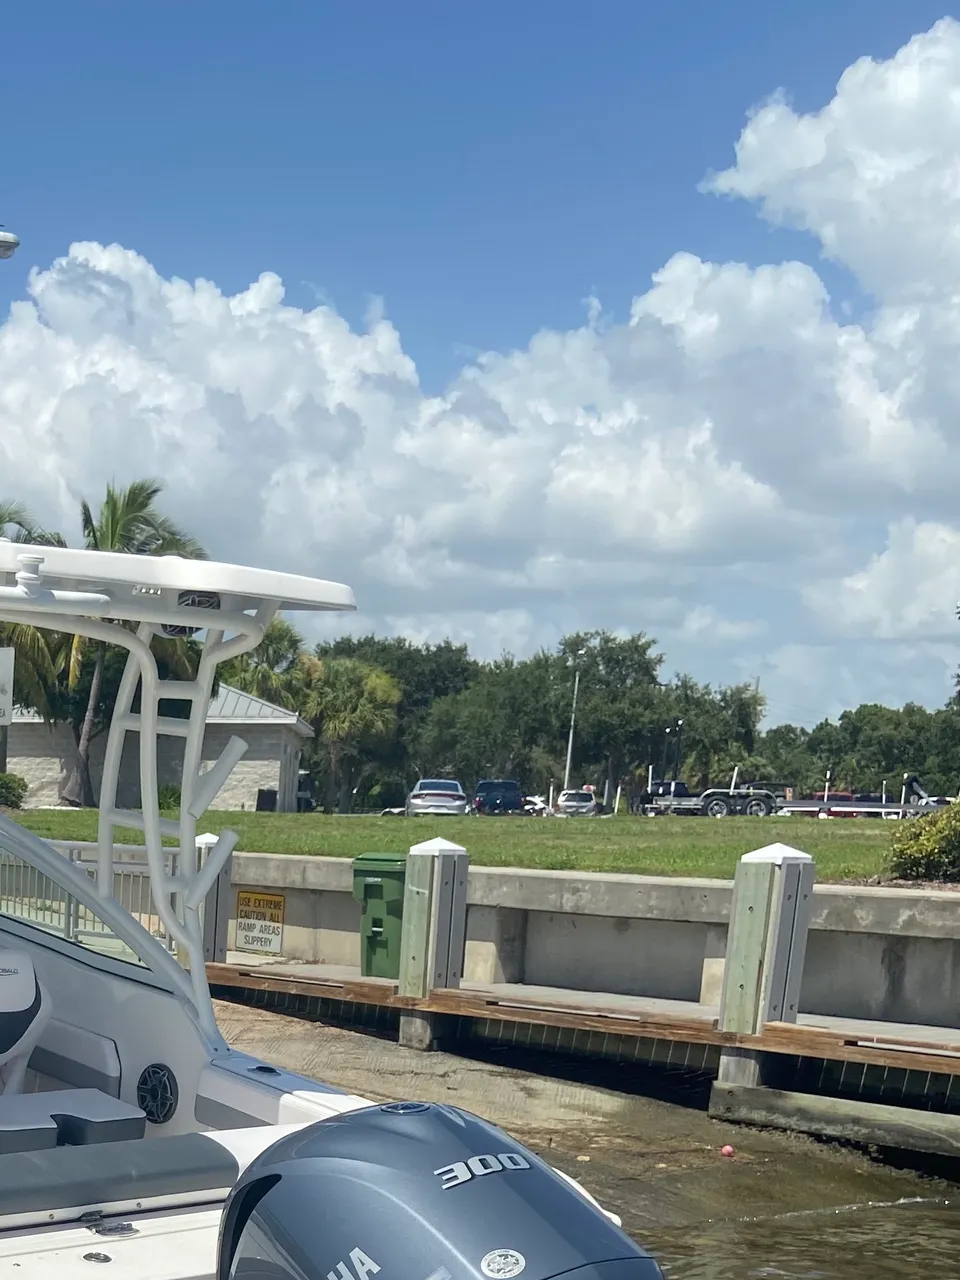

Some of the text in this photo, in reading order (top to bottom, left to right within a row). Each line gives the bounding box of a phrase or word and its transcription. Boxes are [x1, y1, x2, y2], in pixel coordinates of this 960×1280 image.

[239, 896, 283, 911] USE EXTREME
[239, 909, 280, 923] CAUTION ALL
[238, 921, 281, 936] RAMP AREAS
[243, 934, 273, 947] SLIPPERY
[433, 1153, 531, 1190] 300
